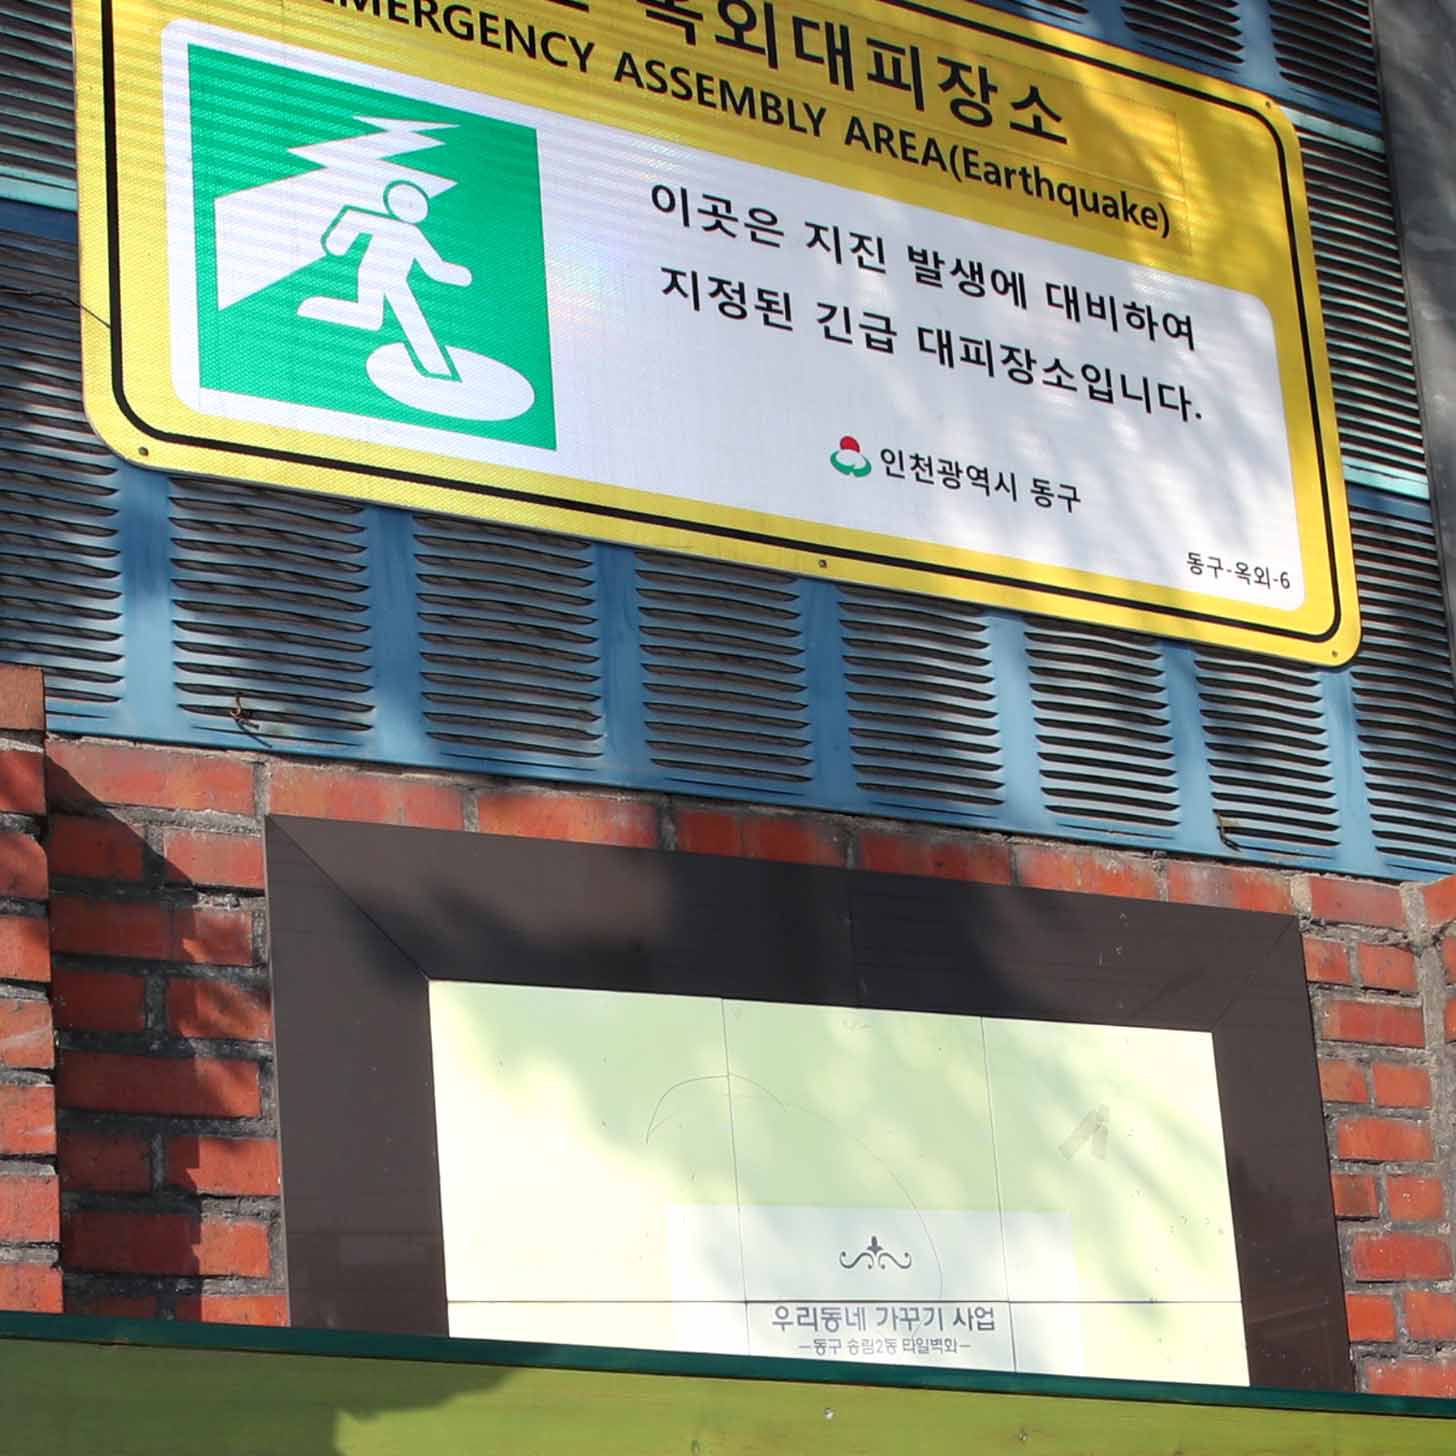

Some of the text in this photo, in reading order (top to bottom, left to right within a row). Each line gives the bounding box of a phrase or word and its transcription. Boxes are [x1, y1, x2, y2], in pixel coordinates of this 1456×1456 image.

[322, 0, 1171, 239] ERGENCY ASSEMBLY AREA(Earthquake)
[651, 184, 1196, 352] 이곳은 지진 발생에 대비하여
[661, 266, 1203, 422] 지정된 긴급 대피장소입니다.
[880, 448, 1082, 513] 인천광역시 동구
[1186, 551, 1292, 590] 동구-옥외-6
[772, 1305, 996, 1333] 우리동네 가꾸기 사업
[847, 1337, 897, 1356] 송림2동
